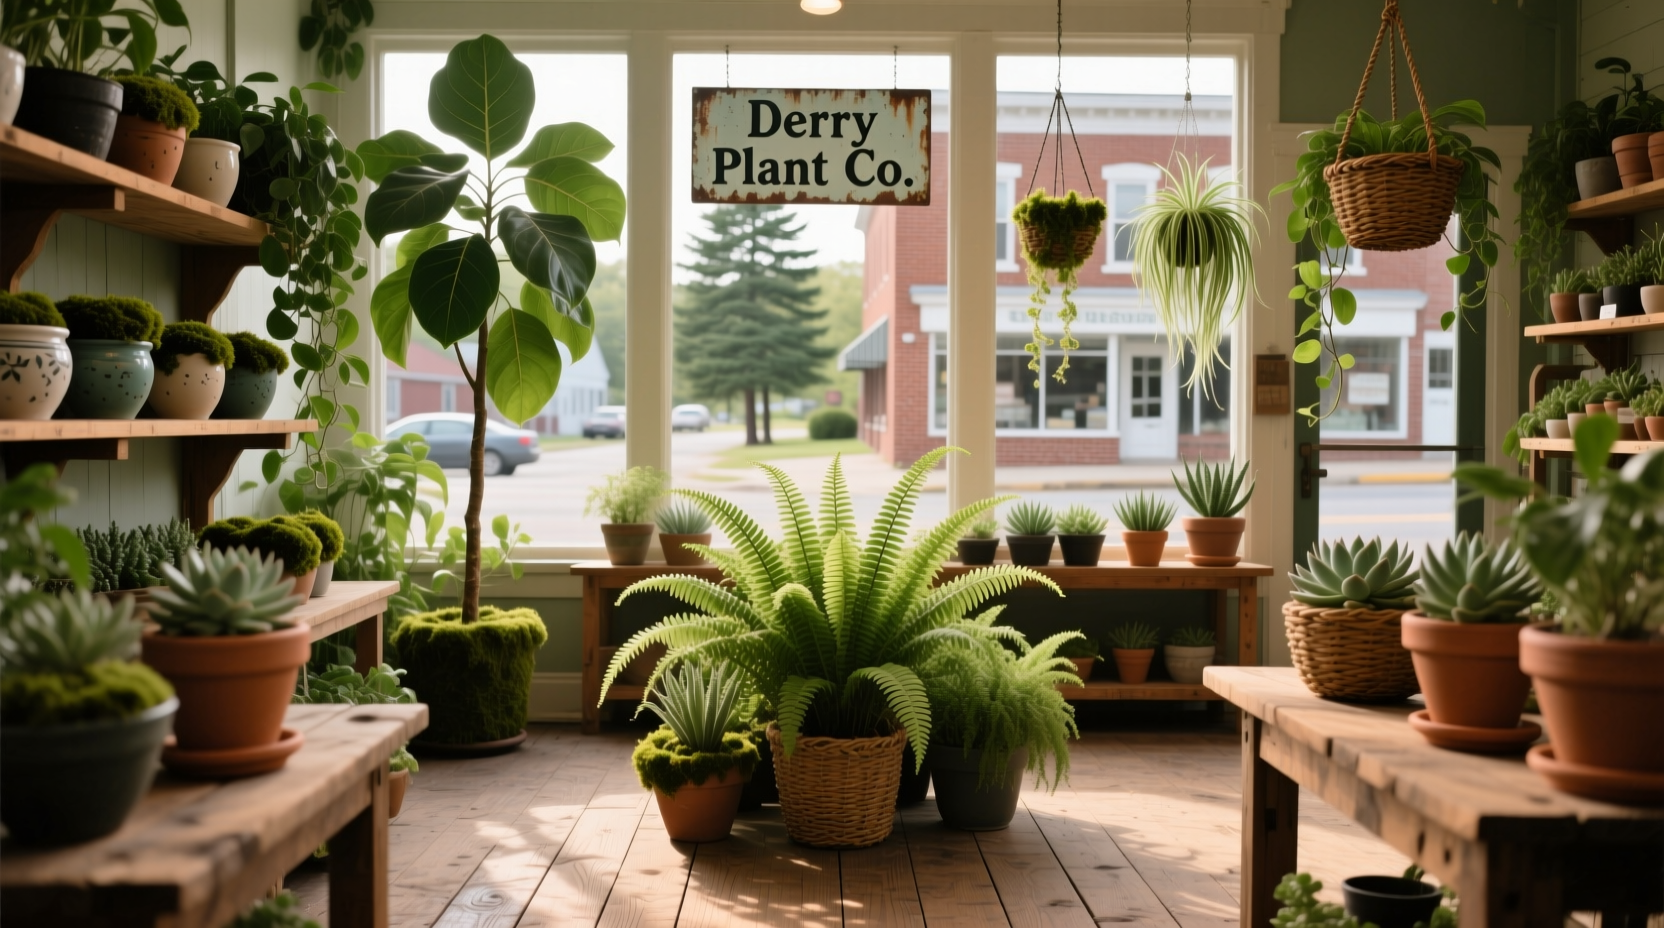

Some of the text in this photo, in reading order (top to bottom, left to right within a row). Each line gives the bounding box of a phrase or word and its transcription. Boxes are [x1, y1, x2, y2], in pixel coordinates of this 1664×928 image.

[748, 99, 879, 148] Derry
[712, 146, 914, 188] Plant Co.
